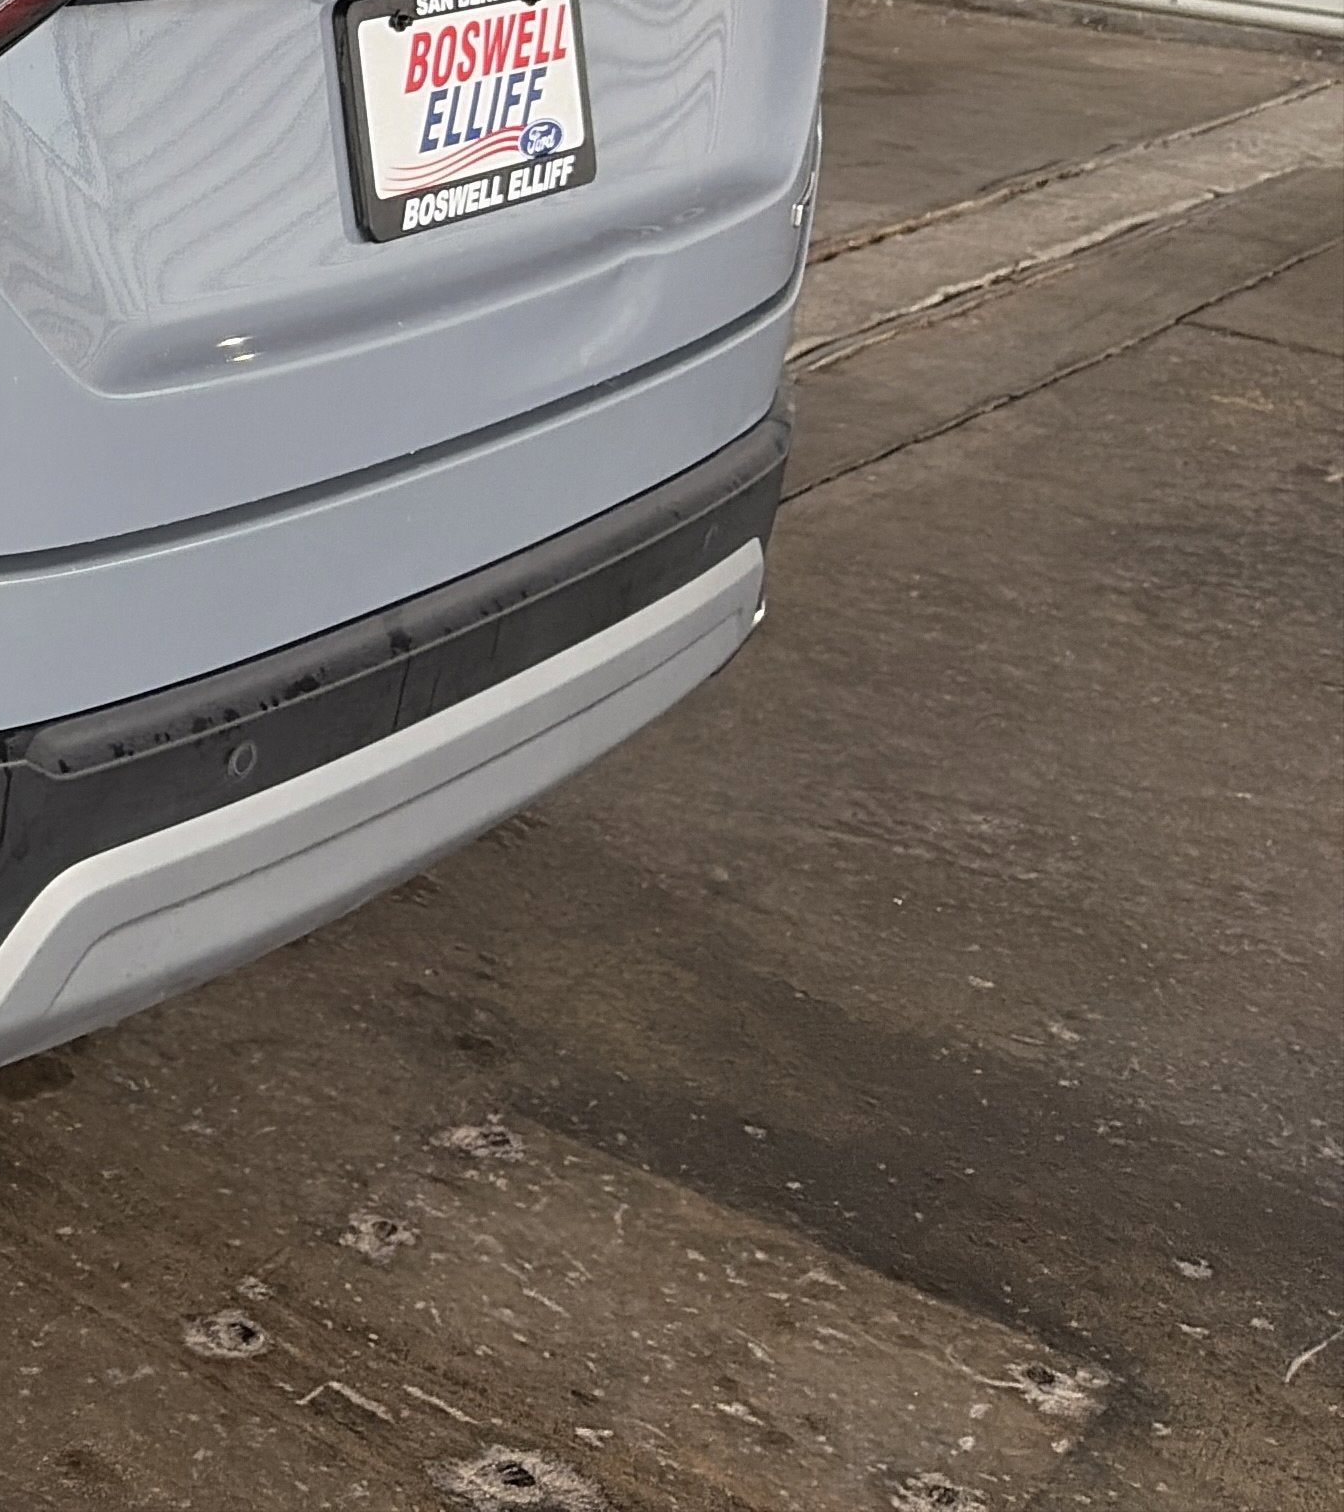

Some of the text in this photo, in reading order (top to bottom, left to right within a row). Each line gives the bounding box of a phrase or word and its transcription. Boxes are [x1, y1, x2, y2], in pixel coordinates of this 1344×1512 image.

[404, 4, 567, 94] BOSWELL
[419, 66, 548, 154] ELLIFF
[402, 154, 575, 231] BOSWELL ELLIFF
